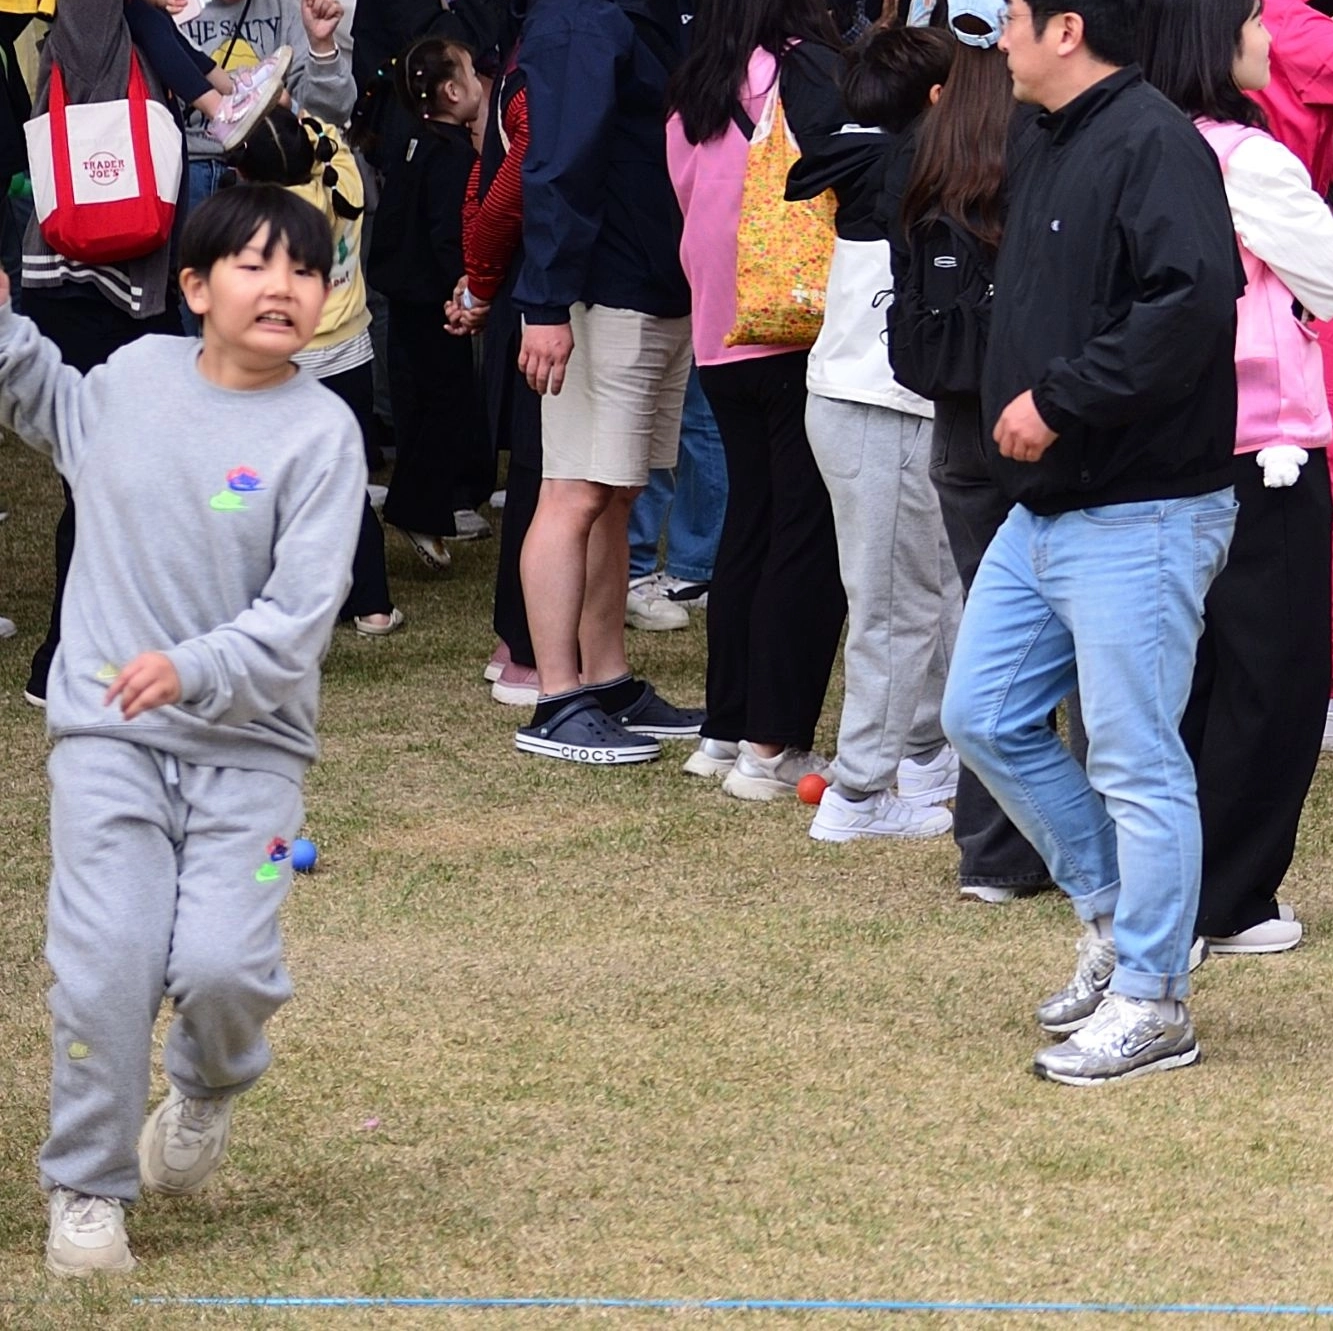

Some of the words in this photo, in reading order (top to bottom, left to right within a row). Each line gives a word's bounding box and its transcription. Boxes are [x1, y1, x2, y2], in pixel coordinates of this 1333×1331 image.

[83, 159, 125, 170] TRADER
[89, 169, 120, 179] JOE'S
[561, 746, 616, 762] crocs
